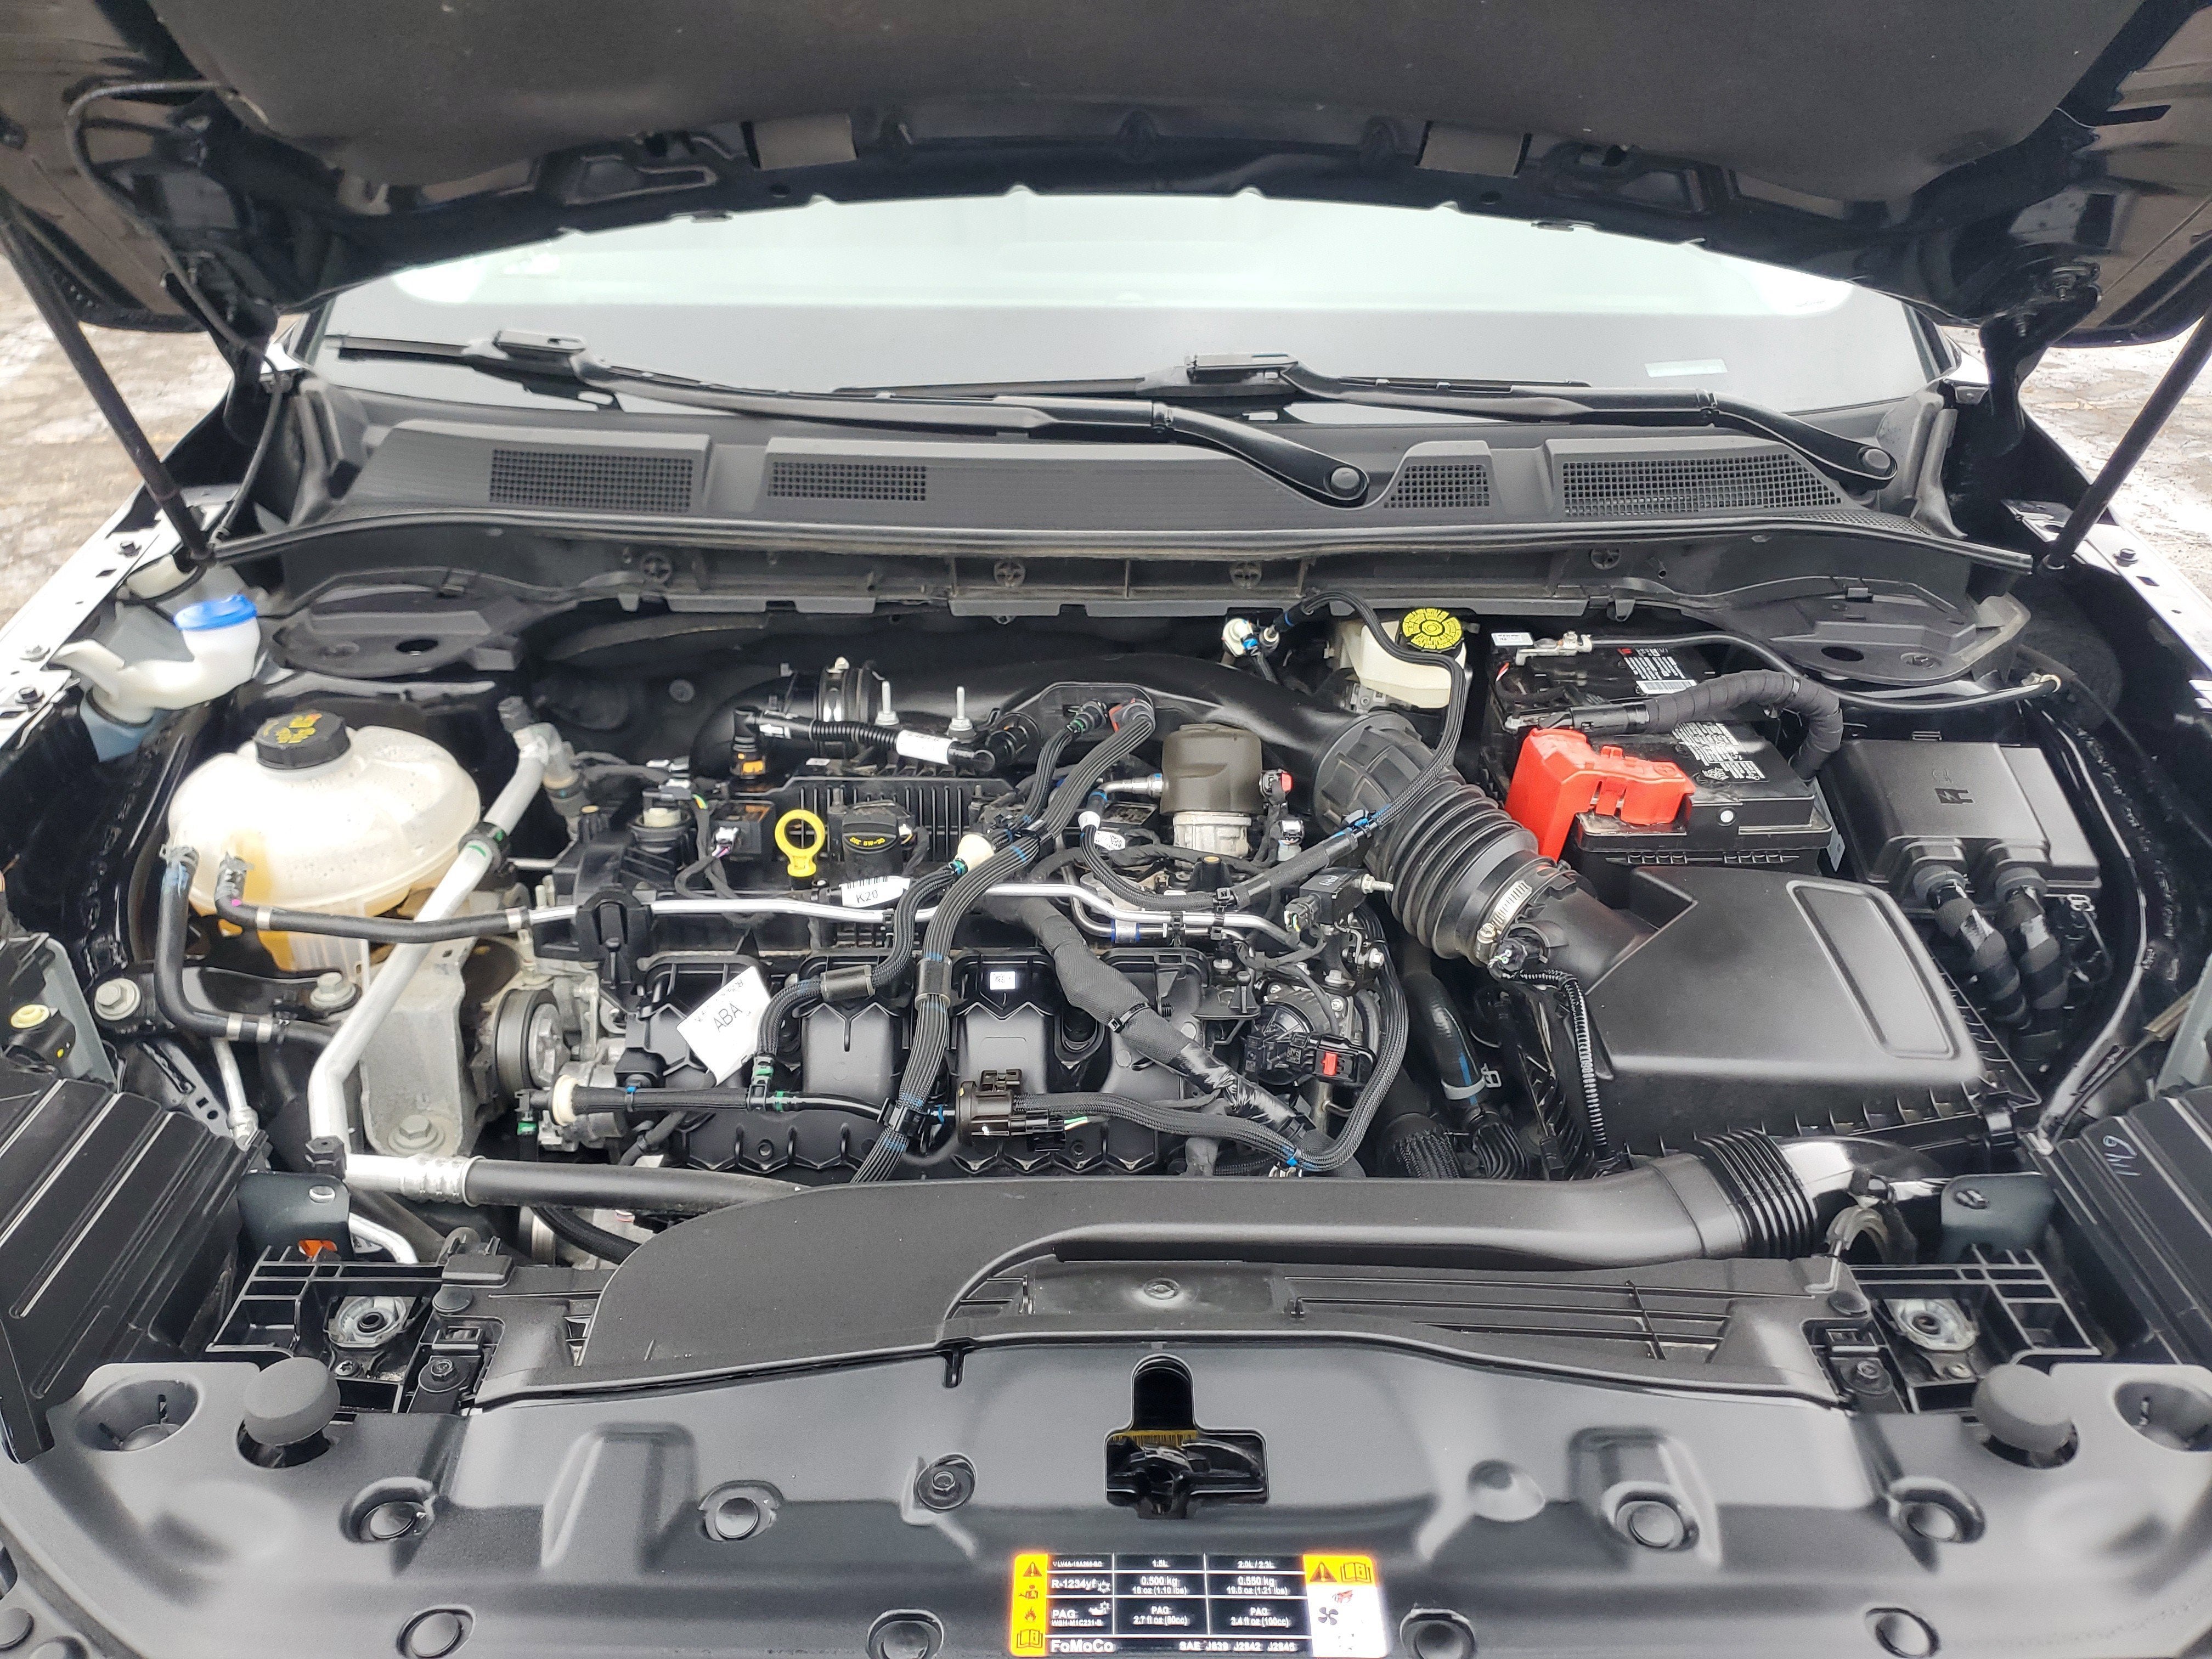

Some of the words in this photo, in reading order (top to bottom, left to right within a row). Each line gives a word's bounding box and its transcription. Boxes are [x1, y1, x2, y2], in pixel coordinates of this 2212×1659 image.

[856, 889, 878, 904] K20
[713, 1003, 743, 1032] ABA
[1051, 1578, 1097, 1590] R-1234yf
[1141, 1576, 1165, 1585] 0.500
[1166, 1576, 1178, 1587] kg
[1263, 1576, 1276, 1587] kg
[1173, 1585, 1188, 1595] lbs)
[1273, 1586, 1288, 1596] lbs)
[1052, 1609, 1077, 1619] PAG
[1151, 1605, 1171, 1615] PAG
[1250, 1606, 1270, 1616] PAG
[1133, 1615, 1146, 1624] 2.7
[1146, 1615, 1153, 1624] fl
[1231, 1616, 1243, 1626] 3.4
[1244, 1616, 1250, 1626] fl
[1250, 1618, 1261, 1626] oz
[1261, 1616, 1290, 1628] (100cc)
[1051, 1639, 1116, 1653] FoMoCo
[1179, 1641, 1203, 1651] SAE
